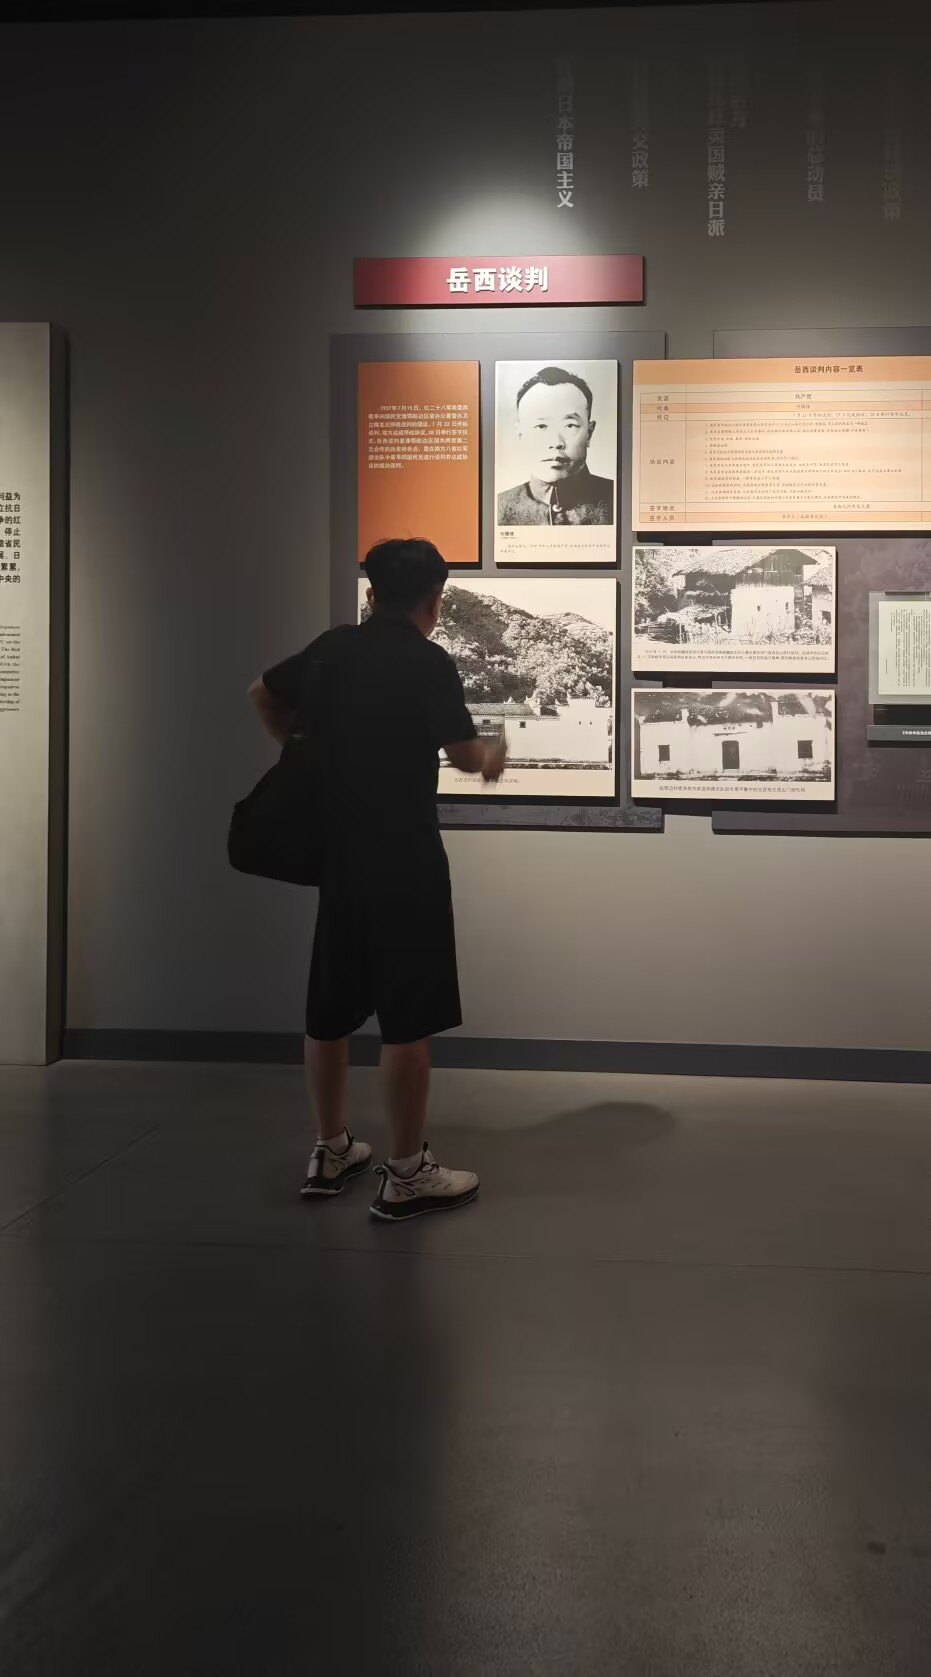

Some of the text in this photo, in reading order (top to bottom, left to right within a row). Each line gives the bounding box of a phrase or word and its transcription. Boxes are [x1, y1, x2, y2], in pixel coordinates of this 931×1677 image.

[446, 265, 549, 293] 岳西谈判
[794, 364, 864, 374] 岳西谈判内容一览表
